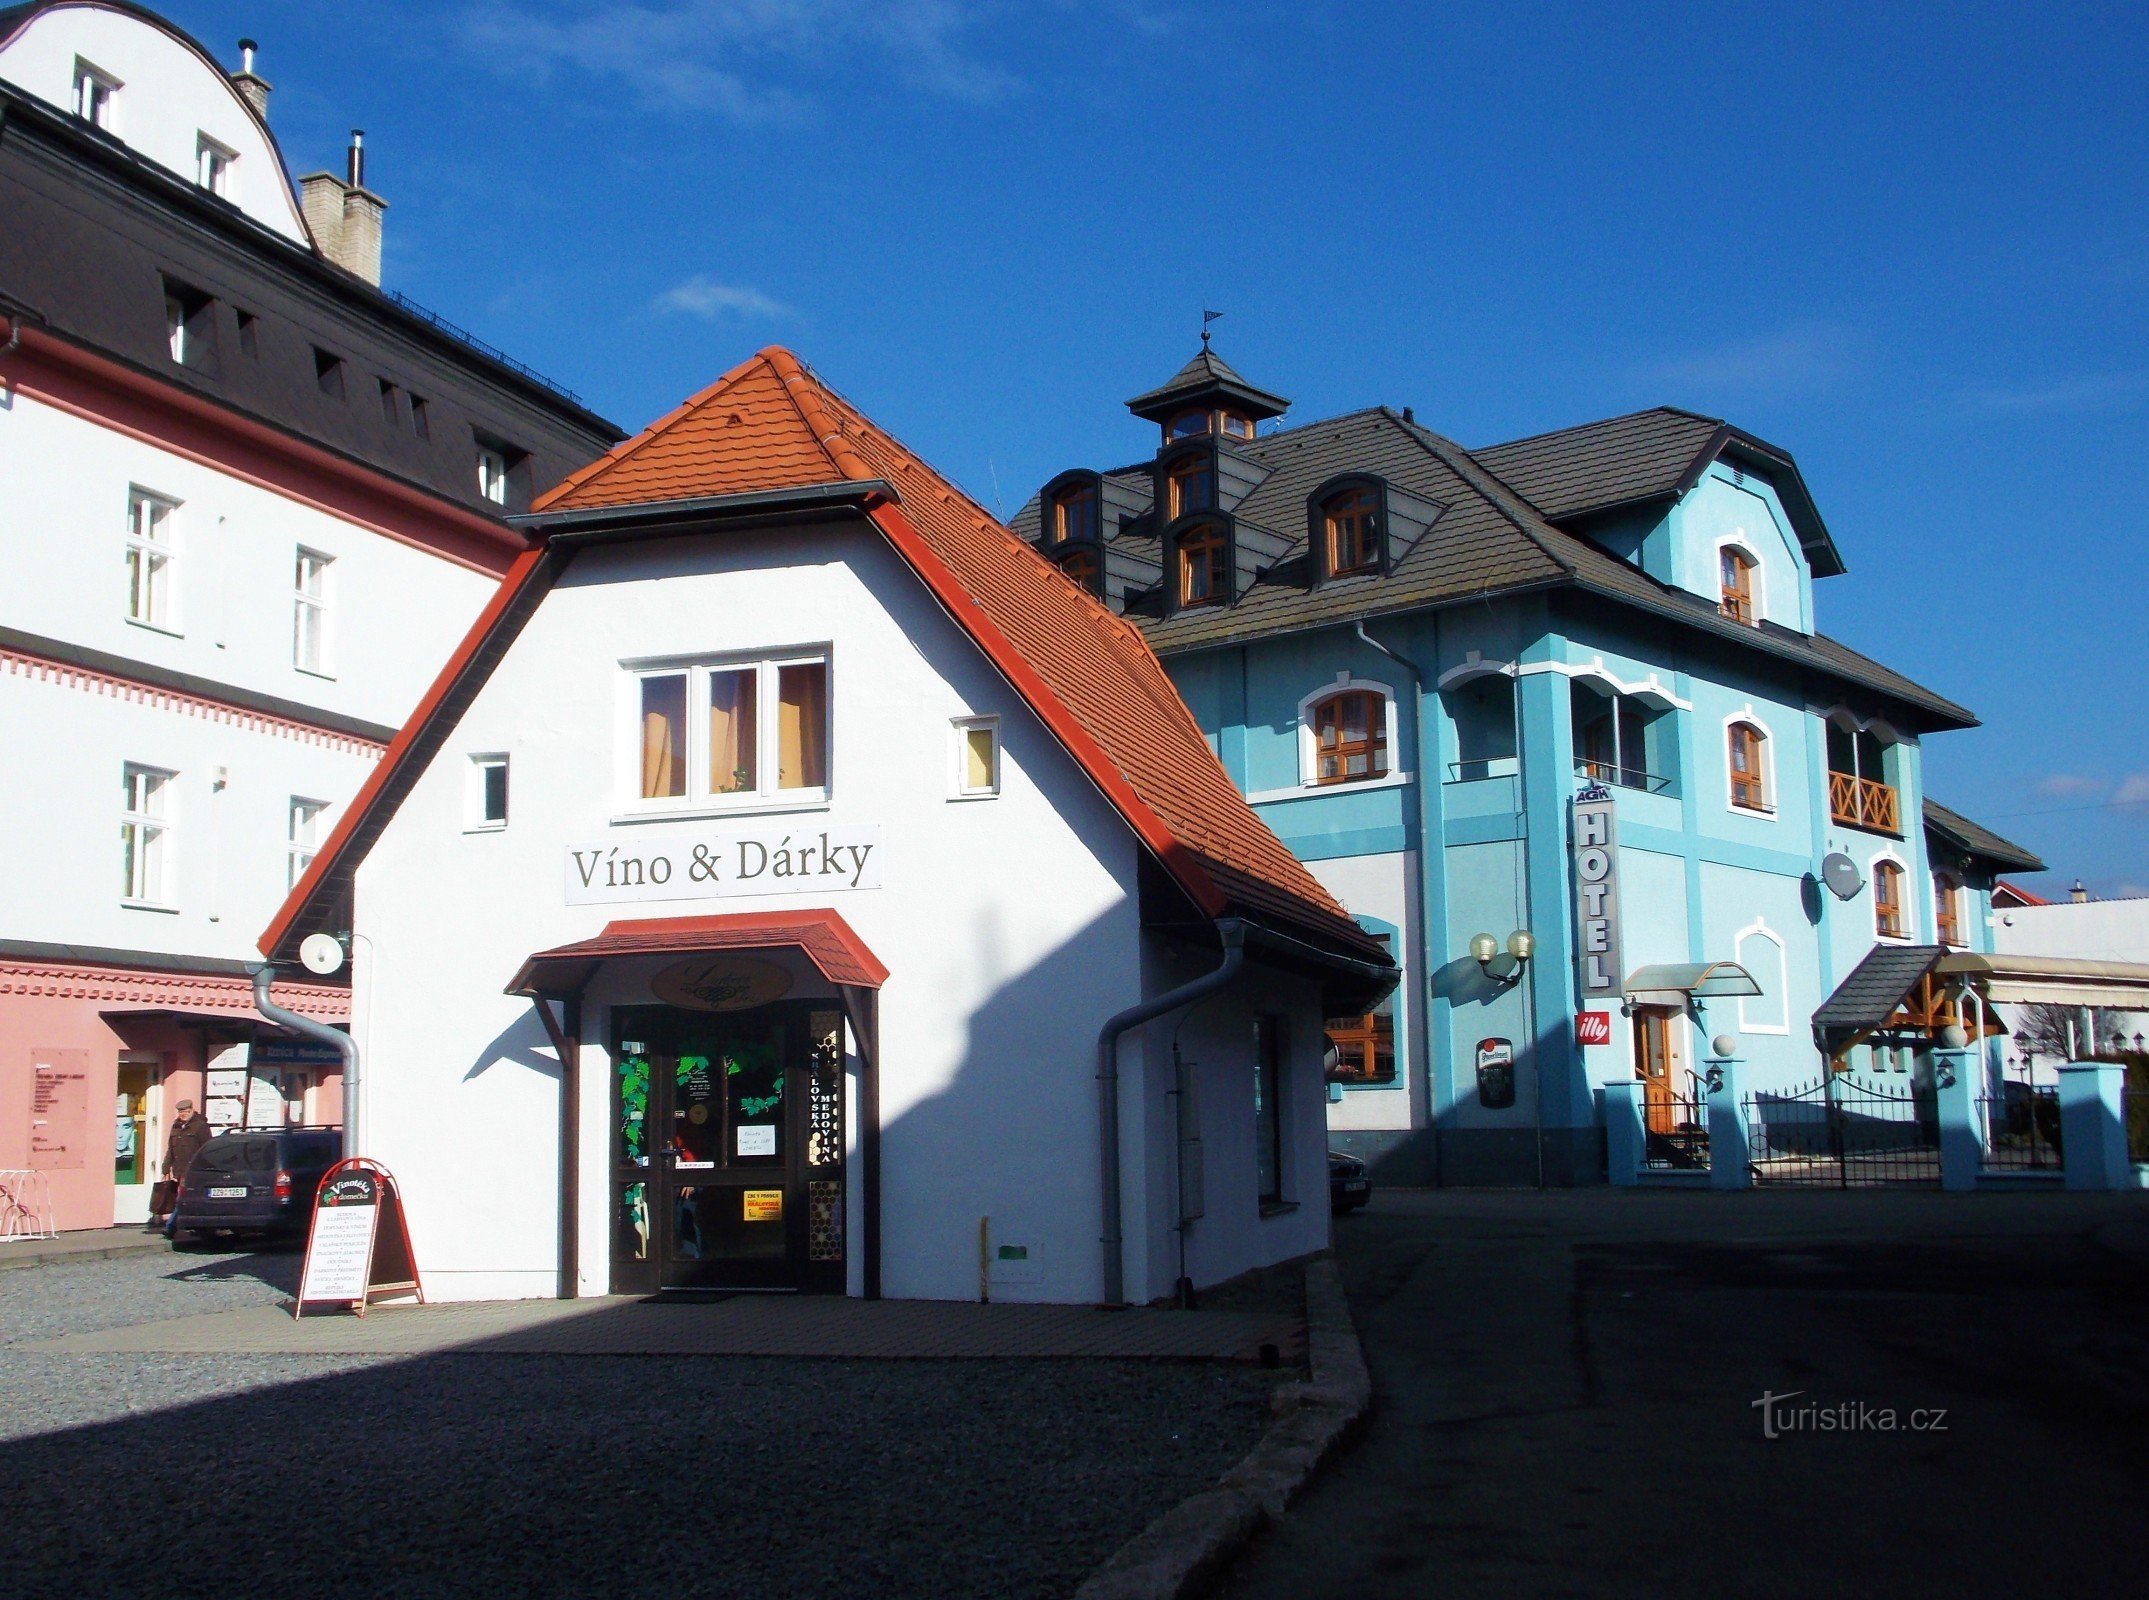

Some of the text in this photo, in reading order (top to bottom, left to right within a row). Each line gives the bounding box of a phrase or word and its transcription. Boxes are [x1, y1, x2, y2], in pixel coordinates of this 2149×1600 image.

[1576, 789, 1609, 801] AGH
[572, 833, 874, 888] Víno & Dárky
[1578, 812, 1609, 988] HOTEL
[1580, 1016, 1608, 1042] illy
[820, 1095, 830, 1163] MEDOVINA
[330, 1180, 370, 1195] Vinotéka
